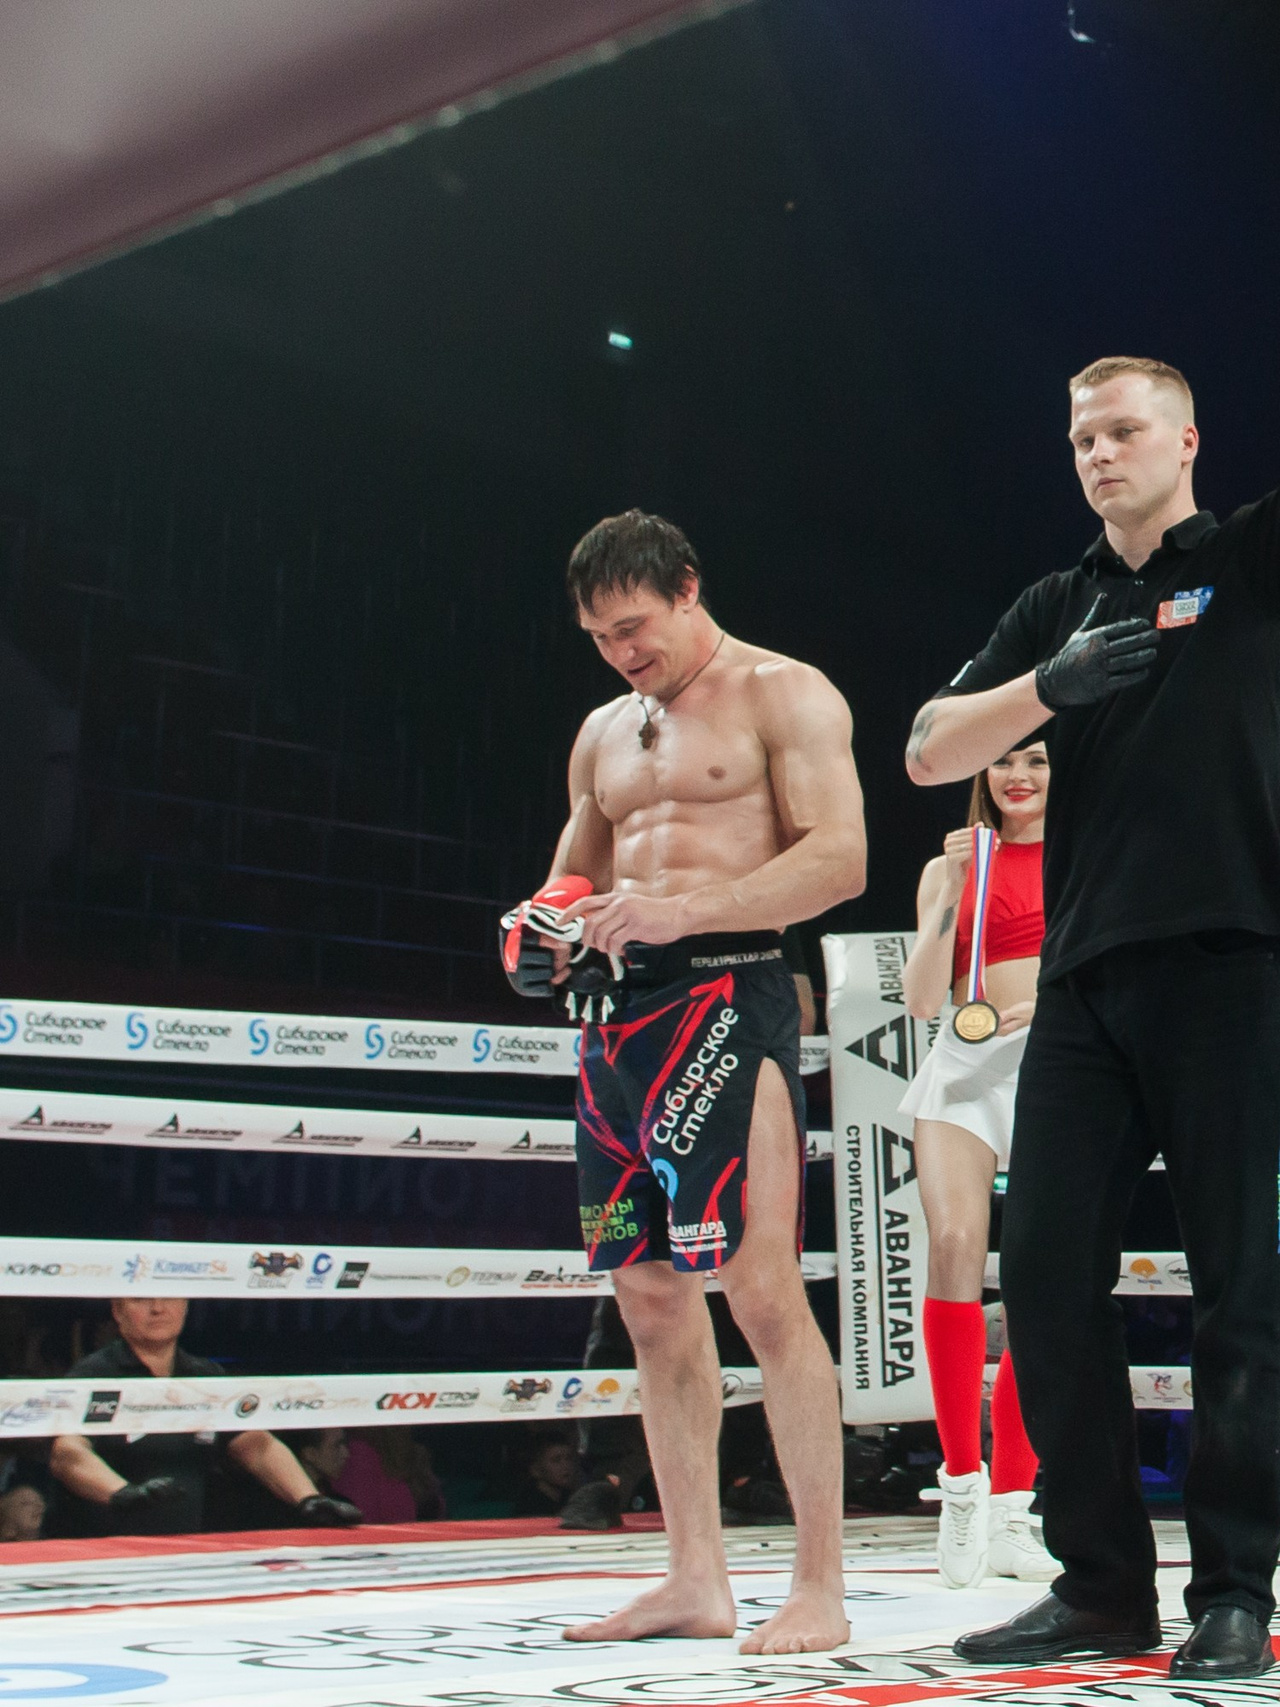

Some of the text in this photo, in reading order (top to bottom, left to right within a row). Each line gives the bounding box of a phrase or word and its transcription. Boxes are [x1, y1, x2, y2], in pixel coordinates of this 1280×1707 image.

[652, 1007, 739, 1145] Сибирское
[671, 1053, 739, 1156] Стекло
[846, 1124, 870, 1390] СТРОИТЕЛЬНАЯ КОМПАНИЯ
[882, 1208, 915, 1387] АВАНГАРД
